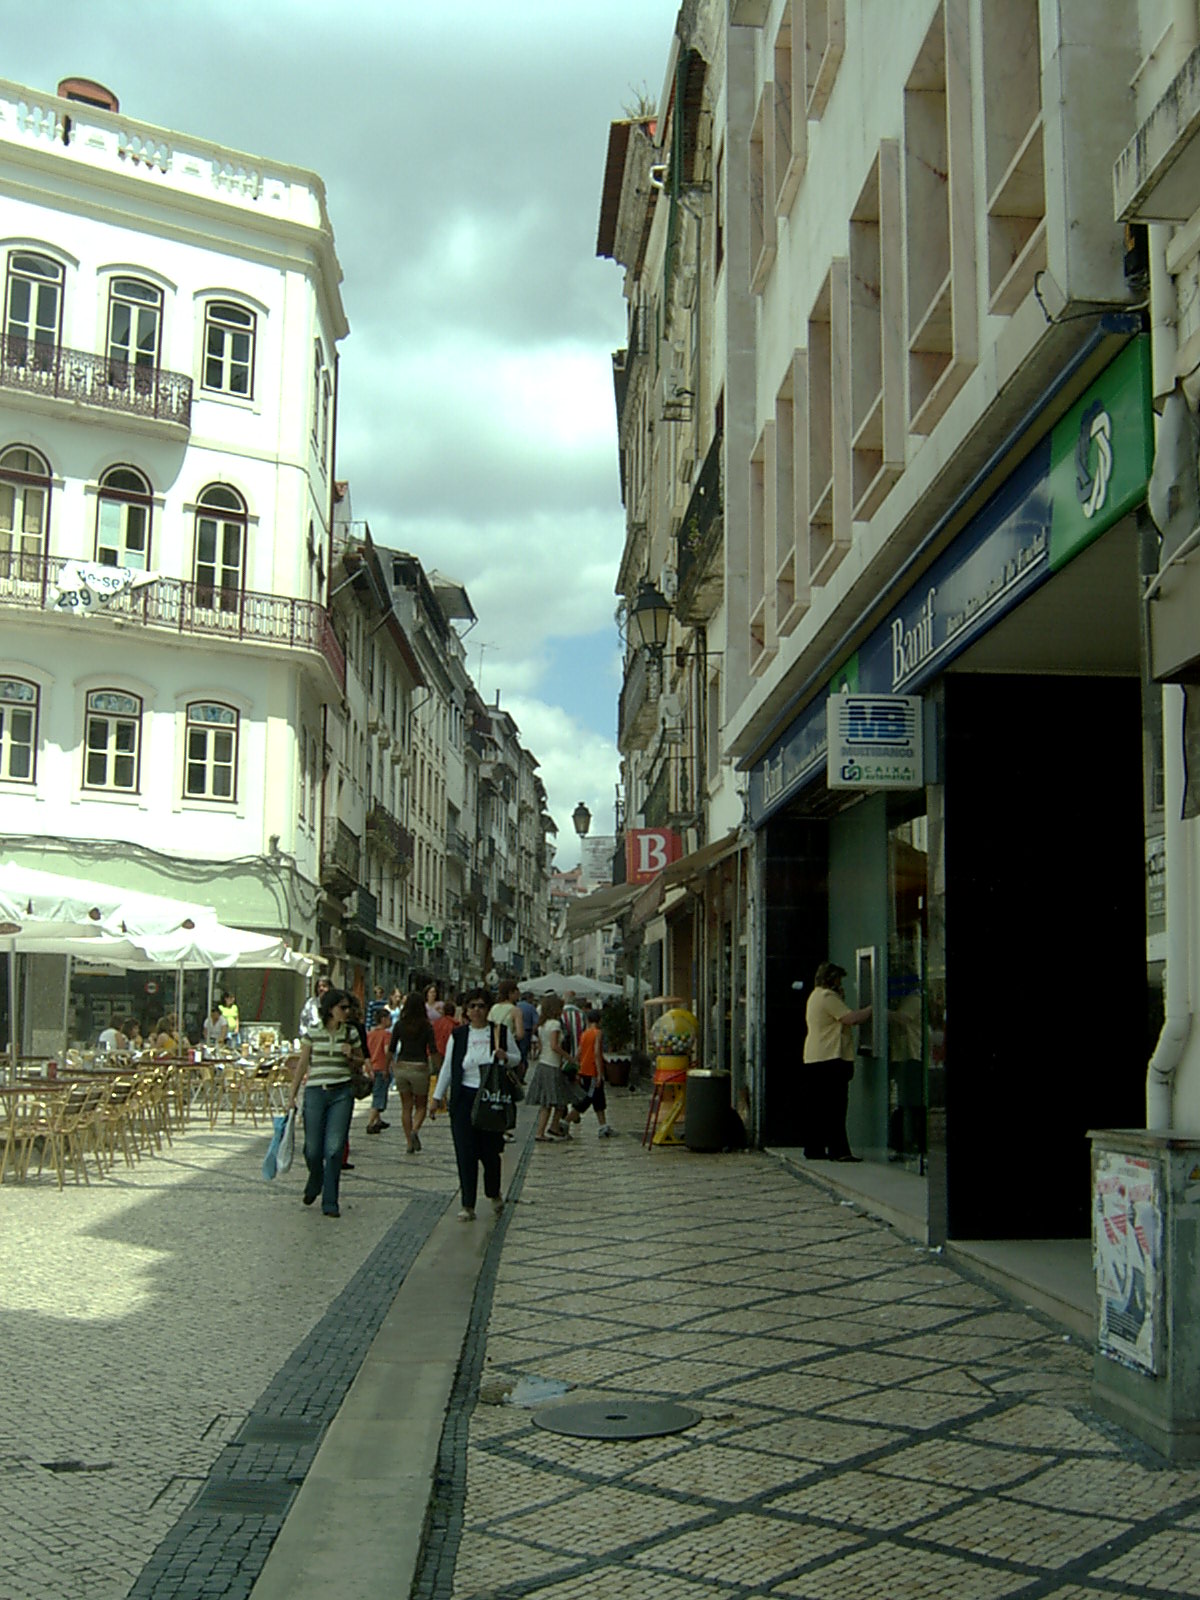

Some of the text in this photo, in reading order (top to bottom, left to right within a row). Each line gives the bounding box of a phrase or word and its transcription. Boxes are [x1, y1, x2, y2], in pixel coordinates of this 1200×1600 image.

[891, 586, 936, 686] Banif
[847, 705, 907, 739] MB
[863, 765, 912, 774] CAIXA
[636, 833, 668, 873] B
